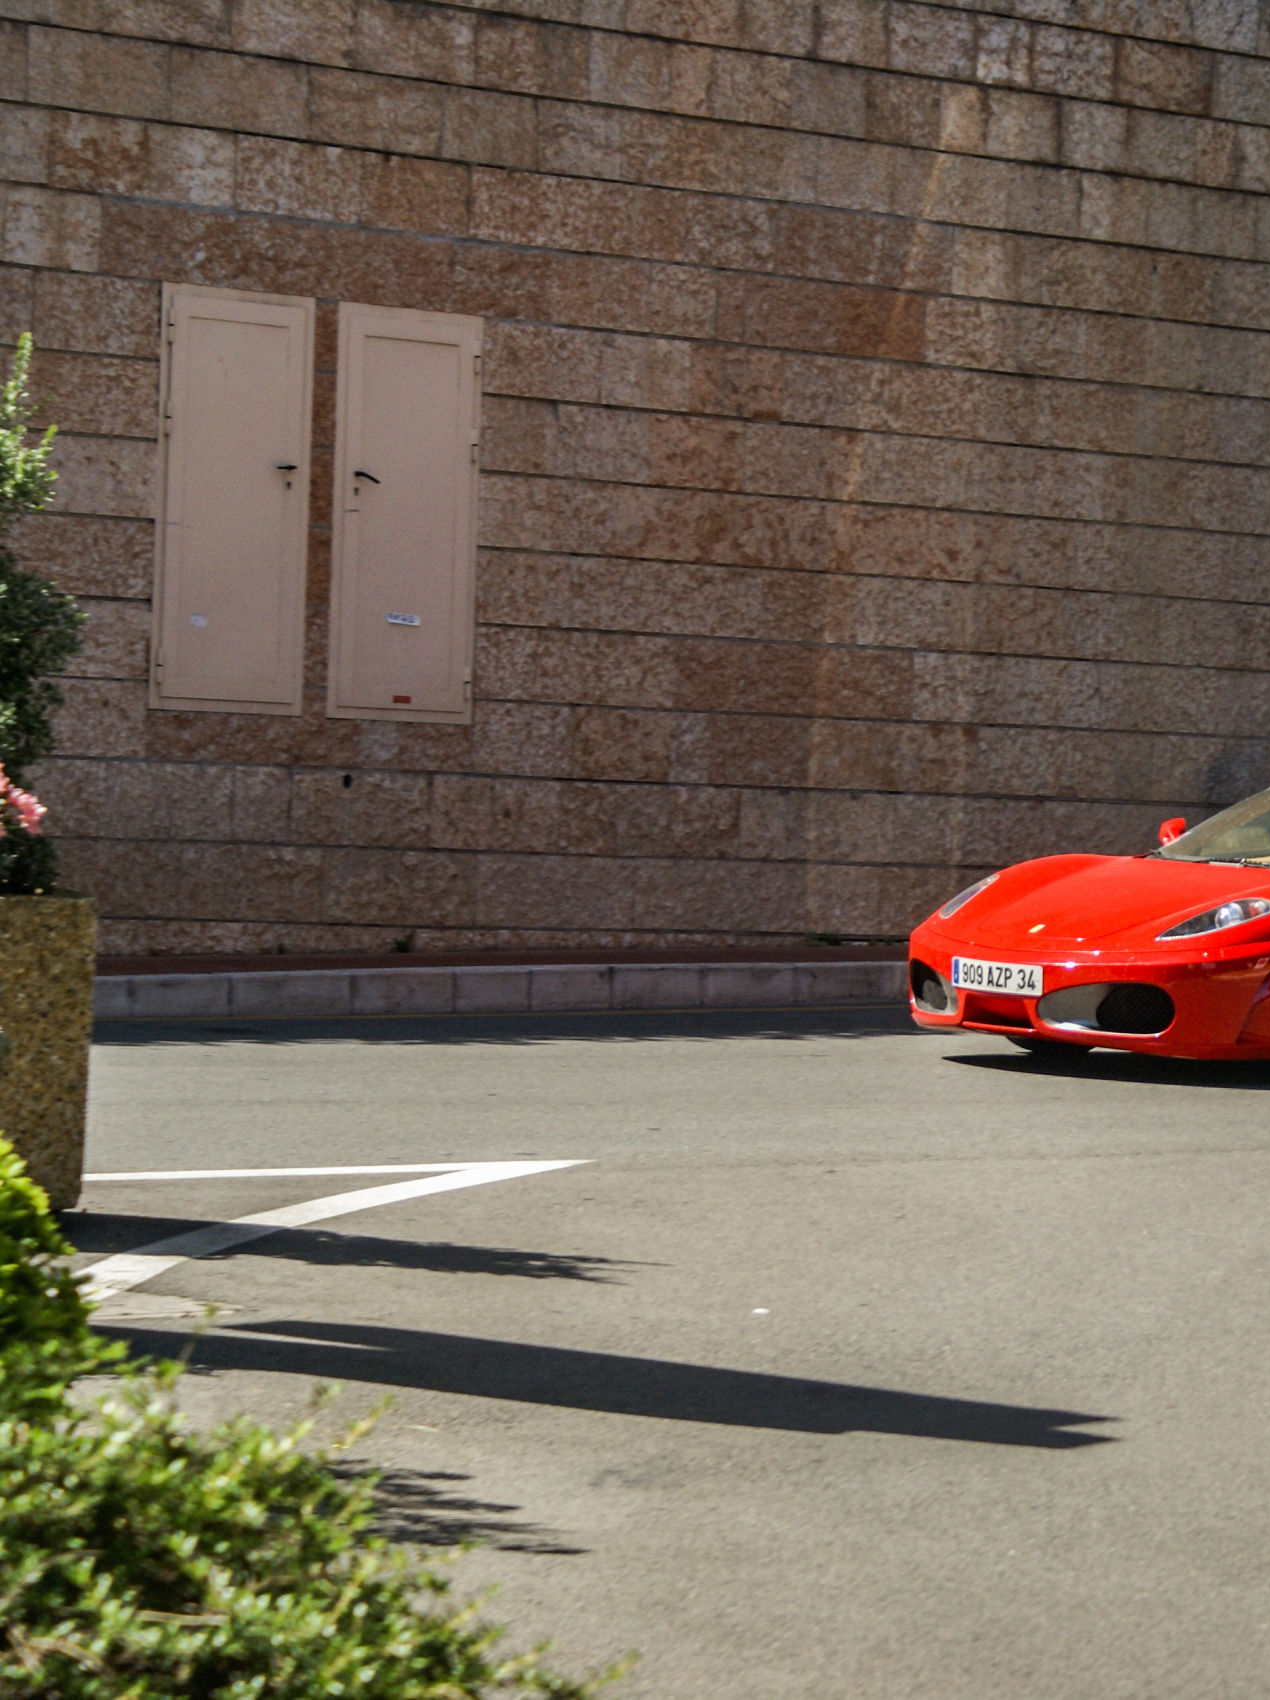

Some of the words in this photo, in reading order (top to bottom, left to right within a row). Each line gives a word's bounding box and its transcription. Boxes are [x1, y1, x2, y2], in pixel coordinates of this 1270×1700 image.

[962, 963, 983, 985] 909
[987, 966, 1012, 988] AZP
[1017, 969, 1036, 990] 34
